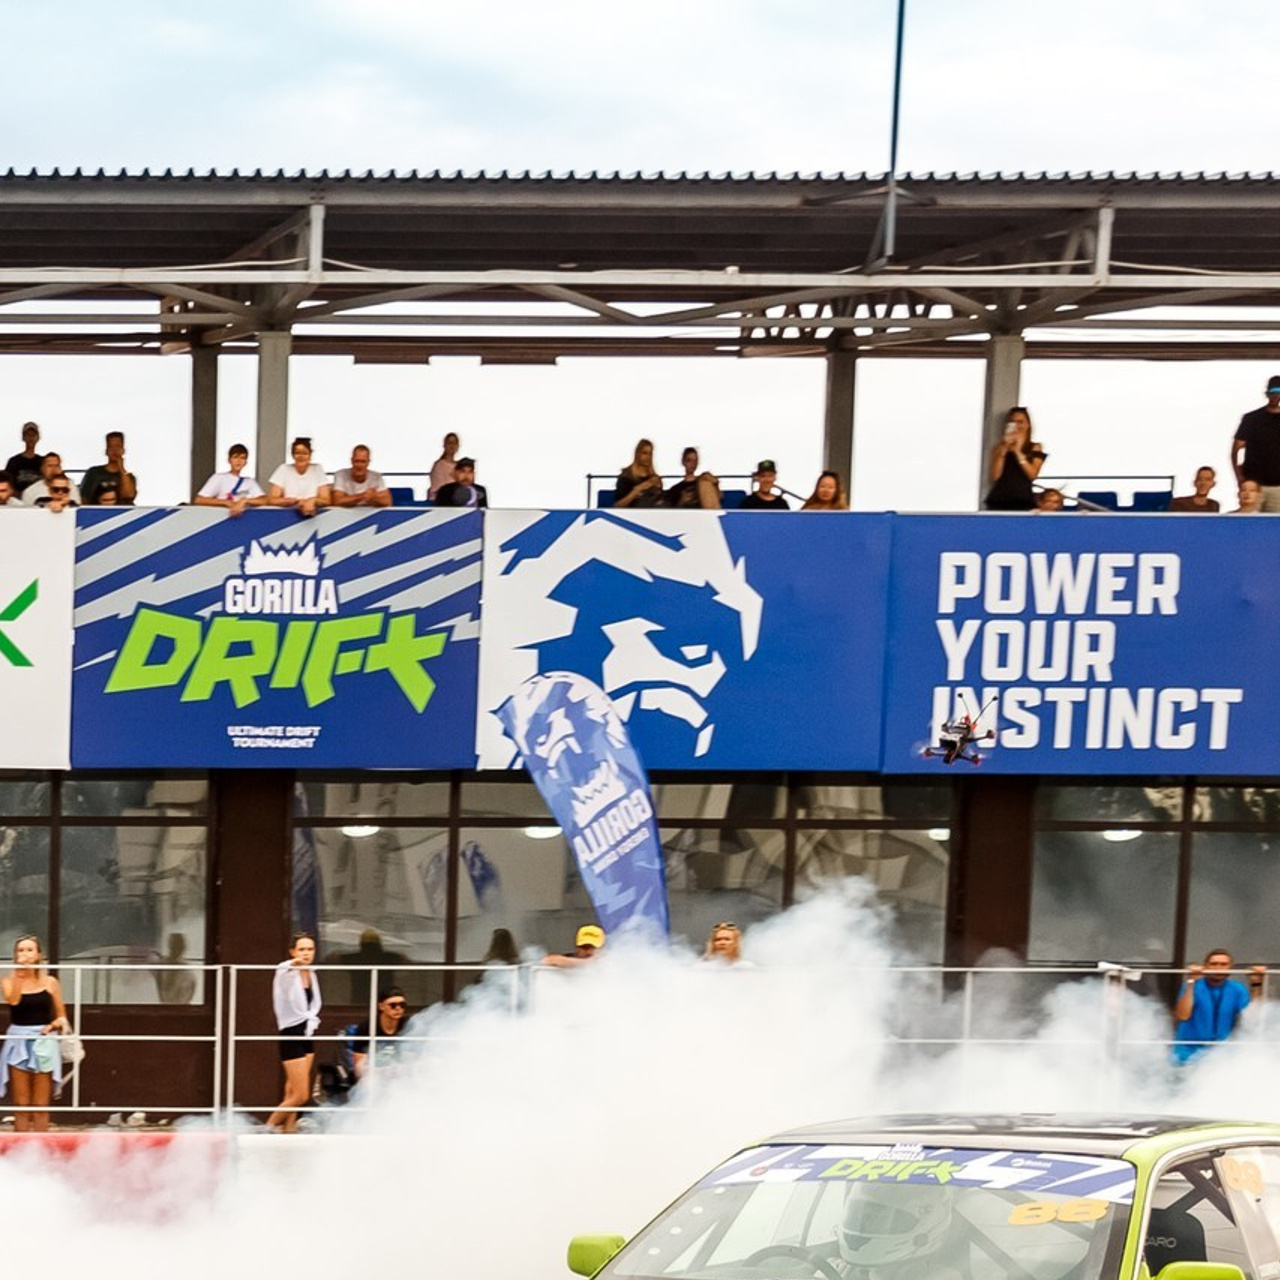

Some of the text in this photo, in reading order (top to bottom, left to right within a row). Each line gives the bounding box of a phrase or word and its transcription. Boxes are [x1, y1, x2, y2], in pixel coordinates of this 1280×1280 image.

[224, 578, 338, 615] GORILLA
[937, 551, 1181, 615] POWER
[103, 607, 449, 714] DRIFT
[935, 619, 1117, 682] YOUR
[227, 726, 321, 737] ULTIMATE DRIFT
[930, 686, 1244, 750] INSTINCT
[232, 737, 315, 749] TOURNAMENT
[817, 1158, 963, 1185] DRIFT
[1008, 1199, 1112, 1226] 88
